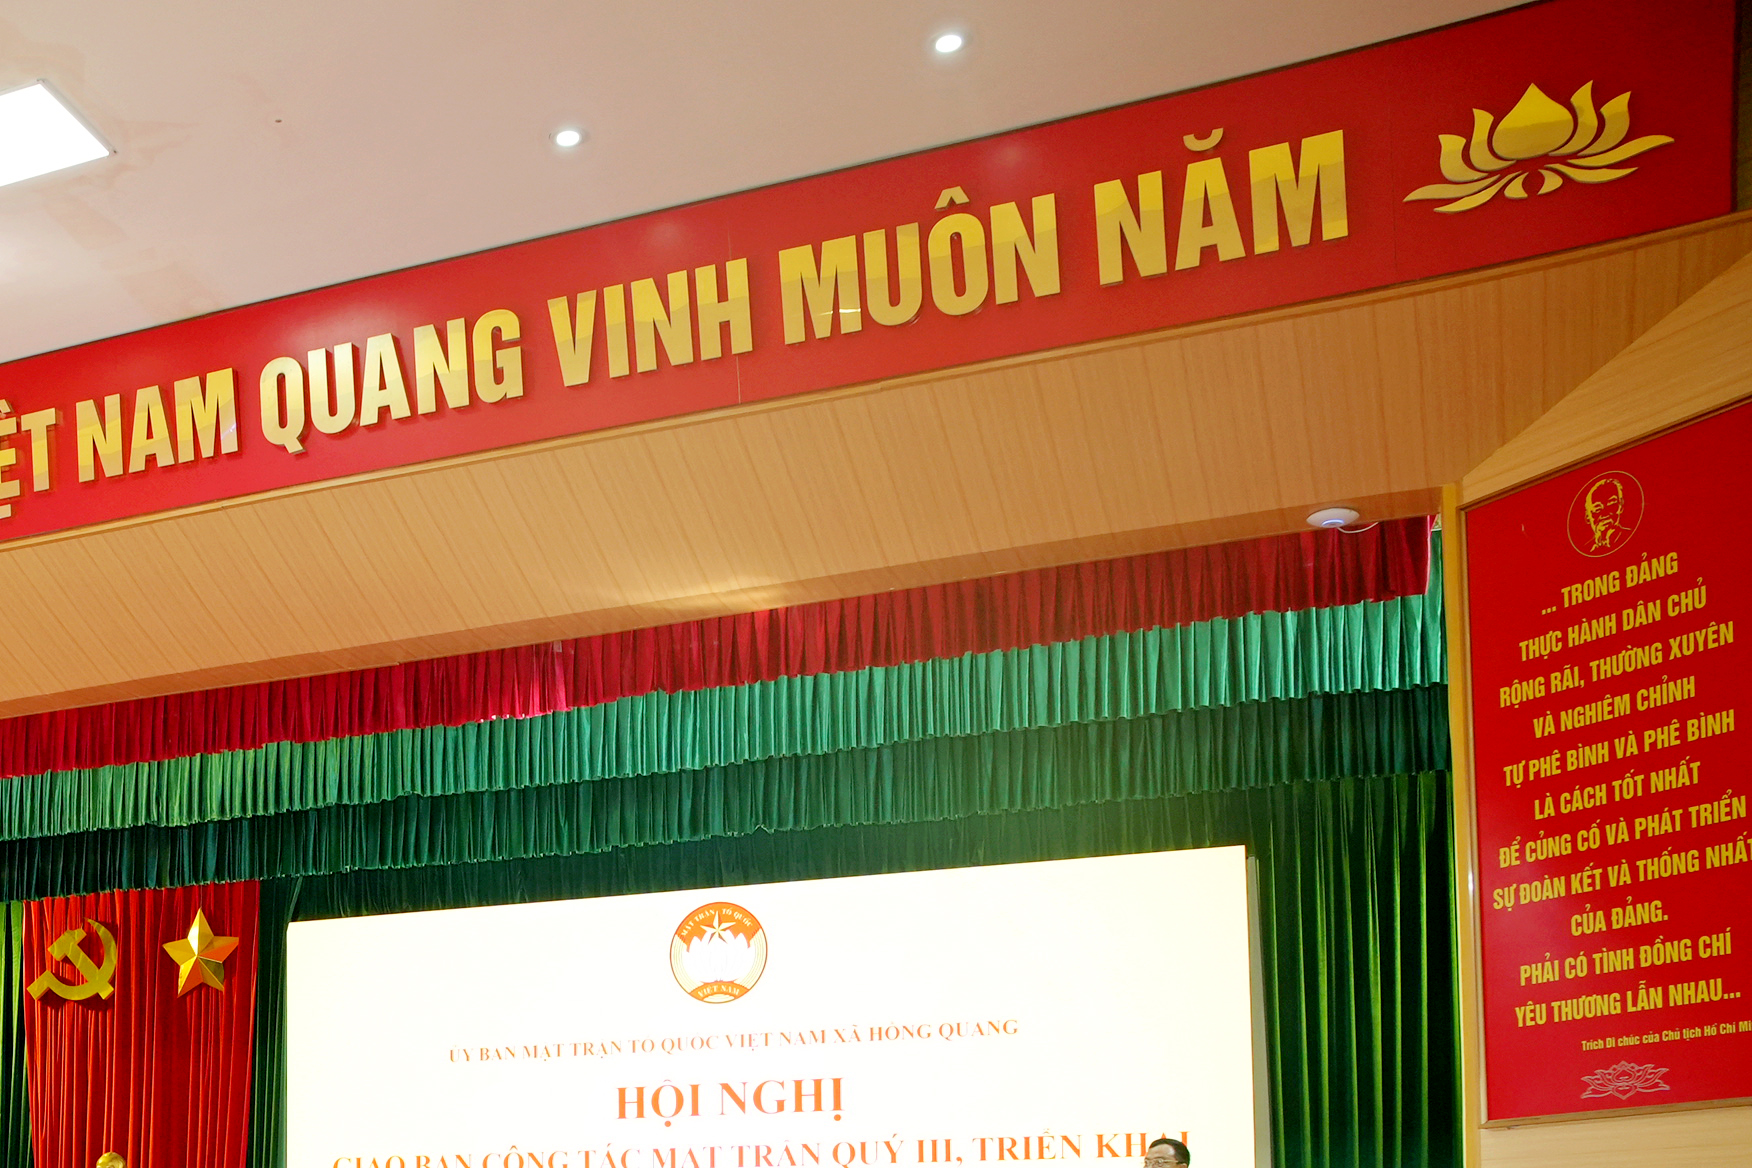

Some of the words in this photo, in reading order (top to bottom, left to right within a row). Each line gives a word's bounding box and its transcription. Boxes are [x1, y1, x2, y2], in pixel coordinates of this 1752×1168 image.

[76, 368, 238, 482] NAM
[260, 309, 523, 453] QUANG
[547, 258, 752, 392] VINH
[779, 186, 1060, 344] MUÔN
[1094, 128, 1348, 285] NĂM
[1561, 571, 1620, 607] TRONG
[1626, 552, 1678, 587] ĐẢNG
[1519, 631, 1562, 661] THỰC
[1568, 613, 1616, 647] HÀNH
[1623, 600, 1661, 631] DÂN
[1668, 577, 1706, 616] CHỦ
[1500, 677, 1545, 708] RỘNG
[1551, 665, 1584, 693] RÃI,
[1590, 643, 1662, 681] THƯỜNG
[1669, 621, 1733, 660] XUYÊN
[1533, 711, 1555, 738] VÀ
[1560, 694, 1630, 731] NGHIÊM
[1637, 675, 1695, 711] CHỈNH
[1503, 760, 1525, 788] TỰ
[1529, 750, 1561, 780] PHÊ
[1567, 741, 1609, 771] BÌNH
[1614, 731, 1638, 759] VÀ
[1644, 719, 1680, 752] PHÊ
[1687, 709, 1734, 741] BÌNH
[1535, 793, 1555, 820] LÀ
[1560, 784, 1606, 813] CÁCH
[1612, 769, 1644, 801] TỐT
[1650, 756, 1700, 793] NHẤT
[1499, 836, 1521, 868] ĐỂ
[1526, 831, 1571, 862] CỦNG
[1577, 819, 1600, 851] CỐ
[1606, 817, 1629, 845] VÀ
[1635, 808, 1683, 839] PHÁT
[1688, 789, 1746, 828] TRIỂN
[1493, 883, 1517, 912] SỰ
[1519, 875, 1565, 905] ĐOÀN
[1571, 862, 1602, 894] KẾT
[1607, 859, 1631, 887] VÀ
[1636, 847, 1699, 881] THỐNG
[1571, 904, 1606, 936] CỦA
[1611, 896, 1668, 929] ĐẢNG.
[1520, 952, 1559, 986] PHẢI
[1564, 951, 1587, 979] CÓ
[1592, 948, 1634, 974] TÌNH
[1639, 936, 1692, 967] ĐỒNG
[1699, 927, 1731, 958] CHÍ
[1515, 1001, 1546, 1027] YÊU
[1551, 993, 1621, 1022] THƯƠNG
[1627, 980, 1662, 1012] LẪN
[480, 1046, 516, 1061] BAN
[779, 1030, 826, 1046] NAM
[938, 1019, 1019, 1041] QUANG
[616, 1079, 701, 1128] HỘI
[719, 1077, 845, 1122] NGHỊ
[917, 1139, 963, 1165] III,
[1095, 1131, 1191, 1158] KHI
